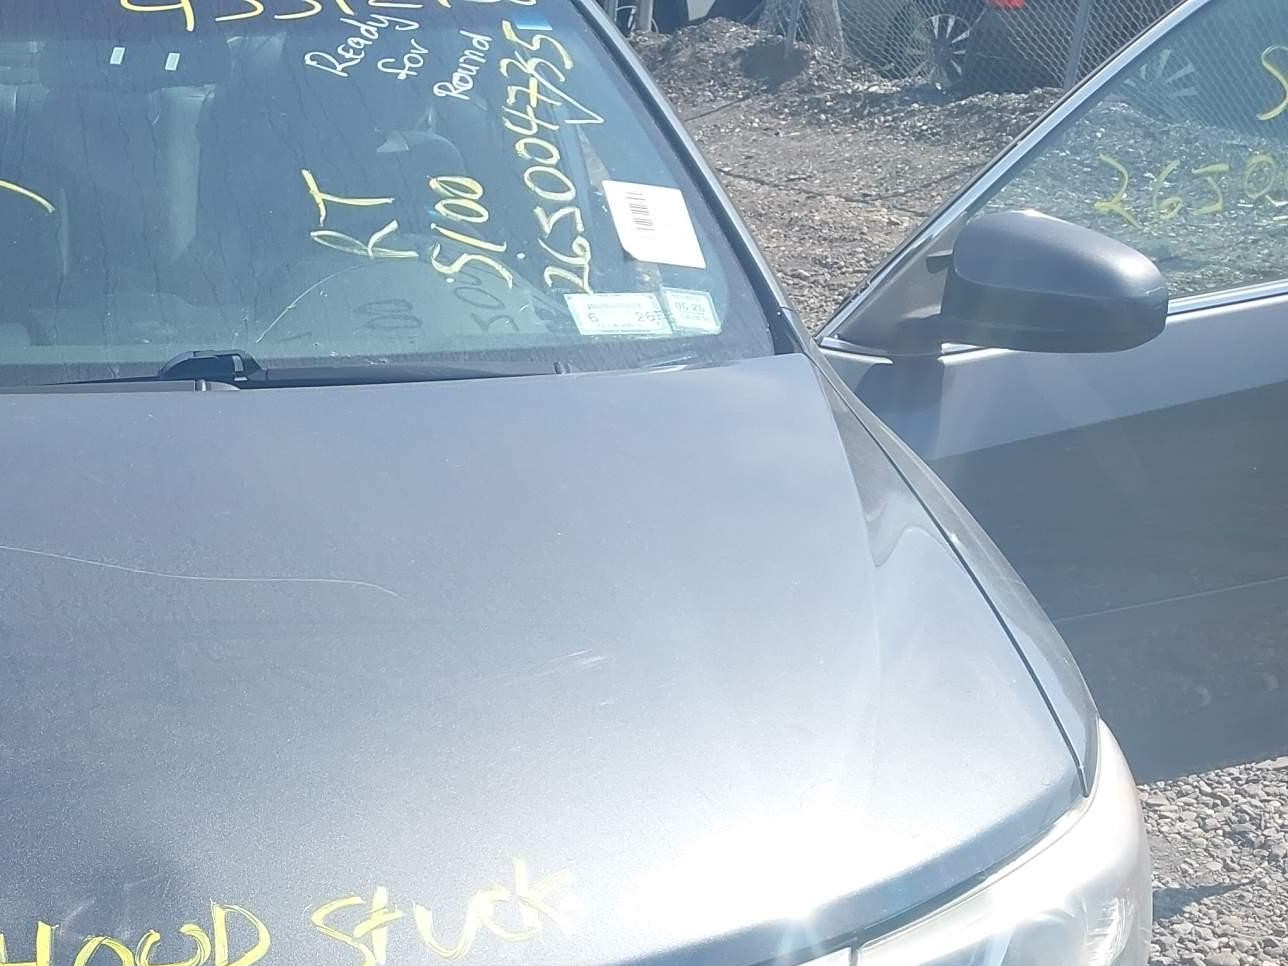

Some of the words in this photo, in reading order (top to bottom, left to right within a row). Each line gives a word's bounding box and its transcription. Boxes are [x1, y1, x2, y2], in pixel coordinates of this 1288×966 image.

[377, 38, 429, 80] for
[432, 30, 493, 100] Round
[301, 168, 420, 260] RT
